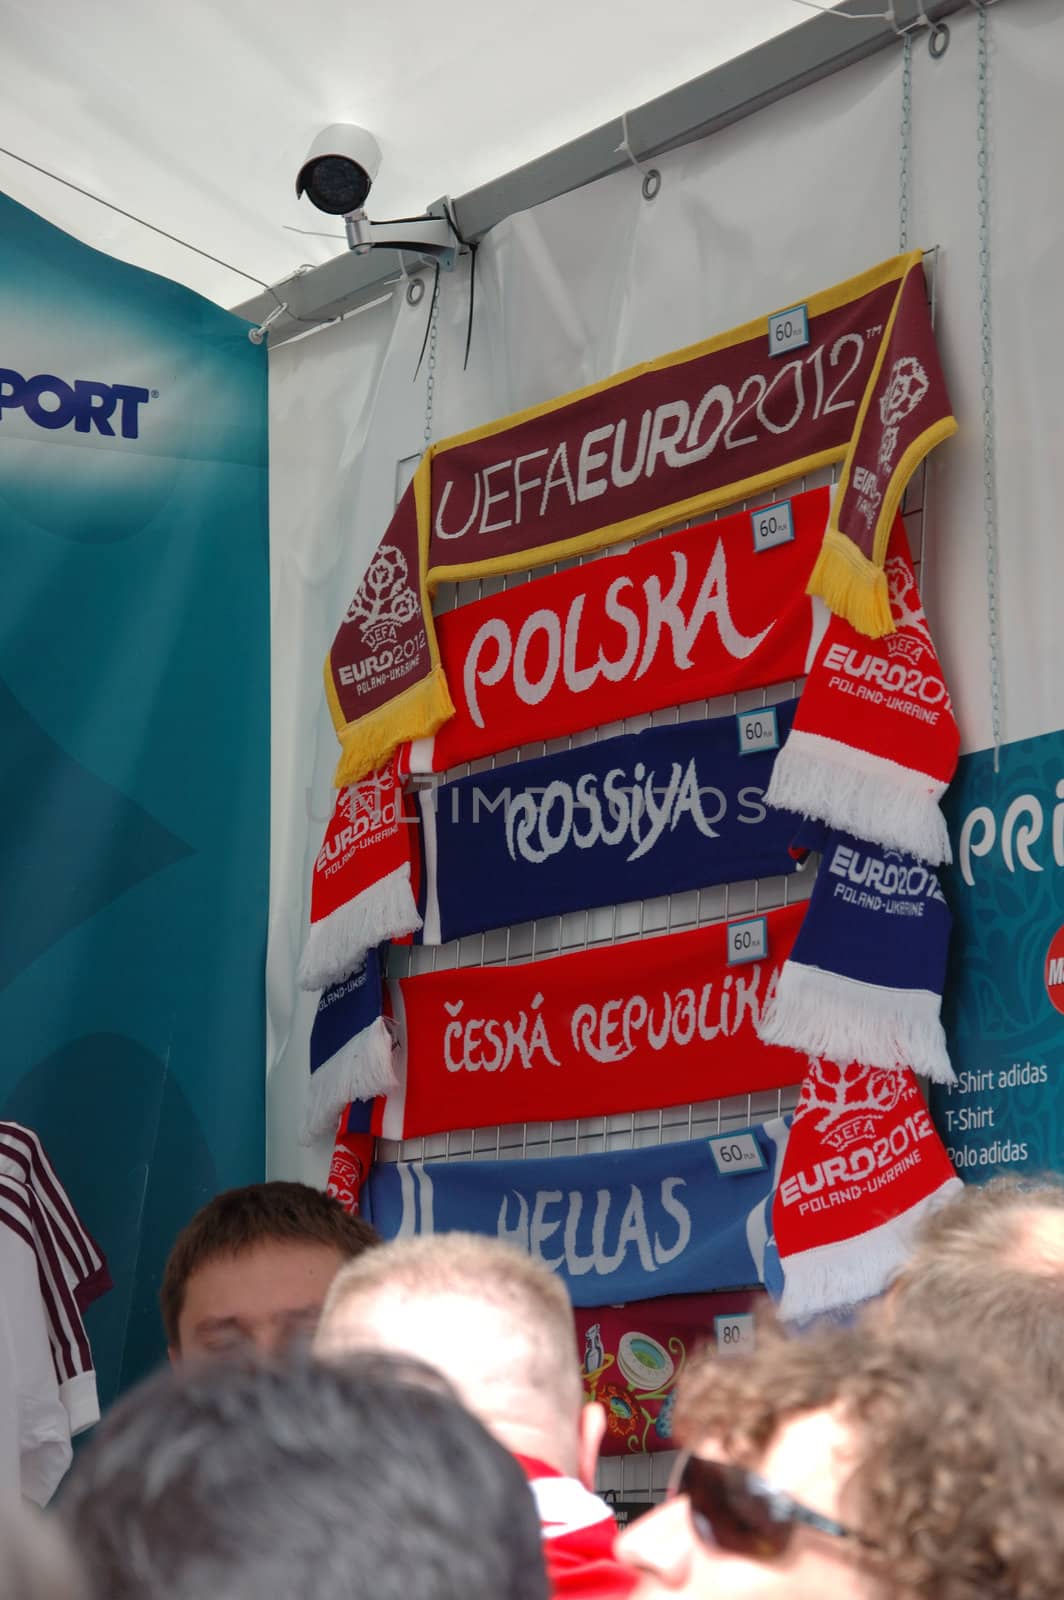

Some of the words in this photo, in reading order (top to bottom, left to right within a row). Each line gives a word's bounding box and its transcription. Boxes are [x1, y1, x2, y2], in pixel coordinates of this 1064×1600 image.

[776, 321, 793, 341] 60
[760, 517, 777, 537] 60
[366, 625, 398, 649] UEFA
[463, 537, 778, 728] POLSKA
[338, 629, 427, 687] EURO2012
[887, 638, 924, 662] UEFA
[828, 676, 941, 726] POLAND-UKRAINE
[746, 722, 763, 740] 60
[833, 882, 925, 917] POLAND-UKRAINE
[734, 931, 751, 950] 60
[444, 992, 561, 1072] ČESKÁ
[998, 1062, 1047, 1088] adidas
[945, 1106, 994, 1132] T-Shirt
[830, 1119, 876, 1148] UEFA
[720, 1145, 742, 1162] 60
[780, 1110, 934, 1207] EURO2012
[947, 1145, 977, 1168] Polo
[980, 1139, 1028, 1165] adidas
[799, 1148, 922, 1216] POLAND-UKRAINE
[497, 1177, 691, 1275] HELLAS
[723, 1325, 740, 1344] 80
